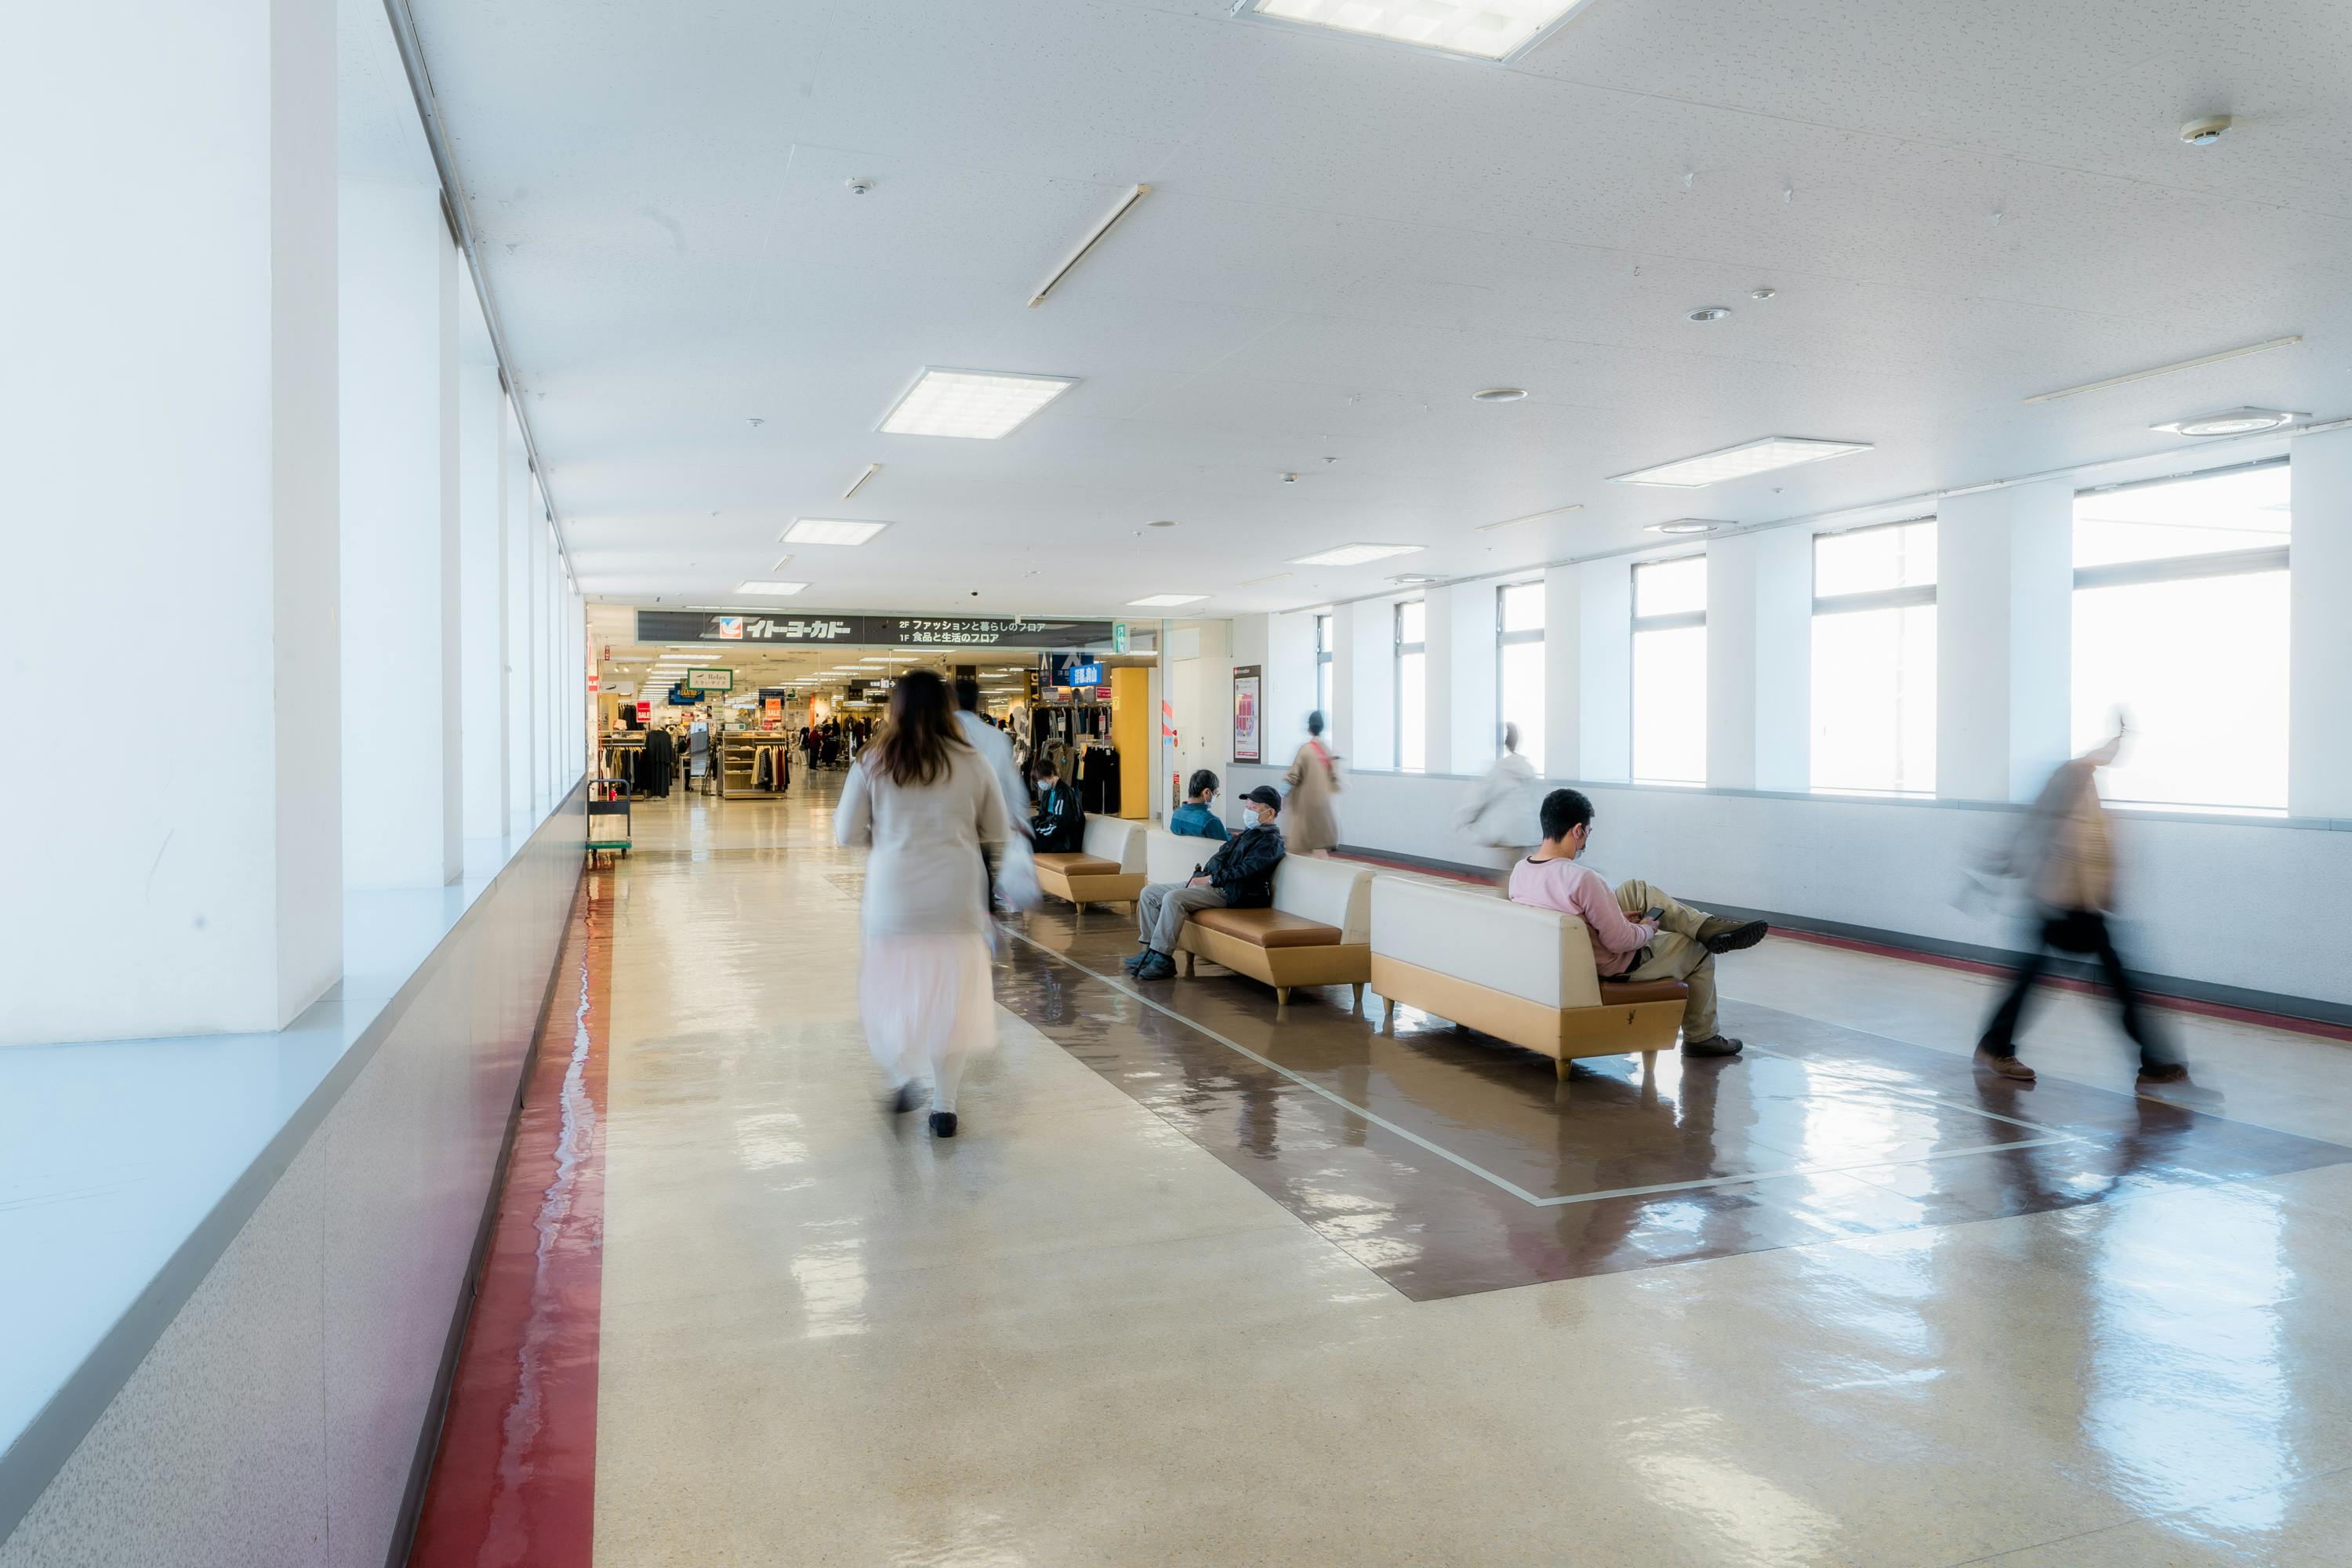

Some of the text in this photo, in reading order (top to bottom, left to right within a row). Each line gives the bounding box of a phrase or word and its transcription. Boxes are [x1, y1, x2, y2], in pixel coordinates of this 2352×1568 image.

[747, 620, 851, 638] イトーヨーカドー
[913, 620, 1046, 633] ファッションと暮らしのフロア
[913, 632, 999, 643] 食品と生活のフロア
